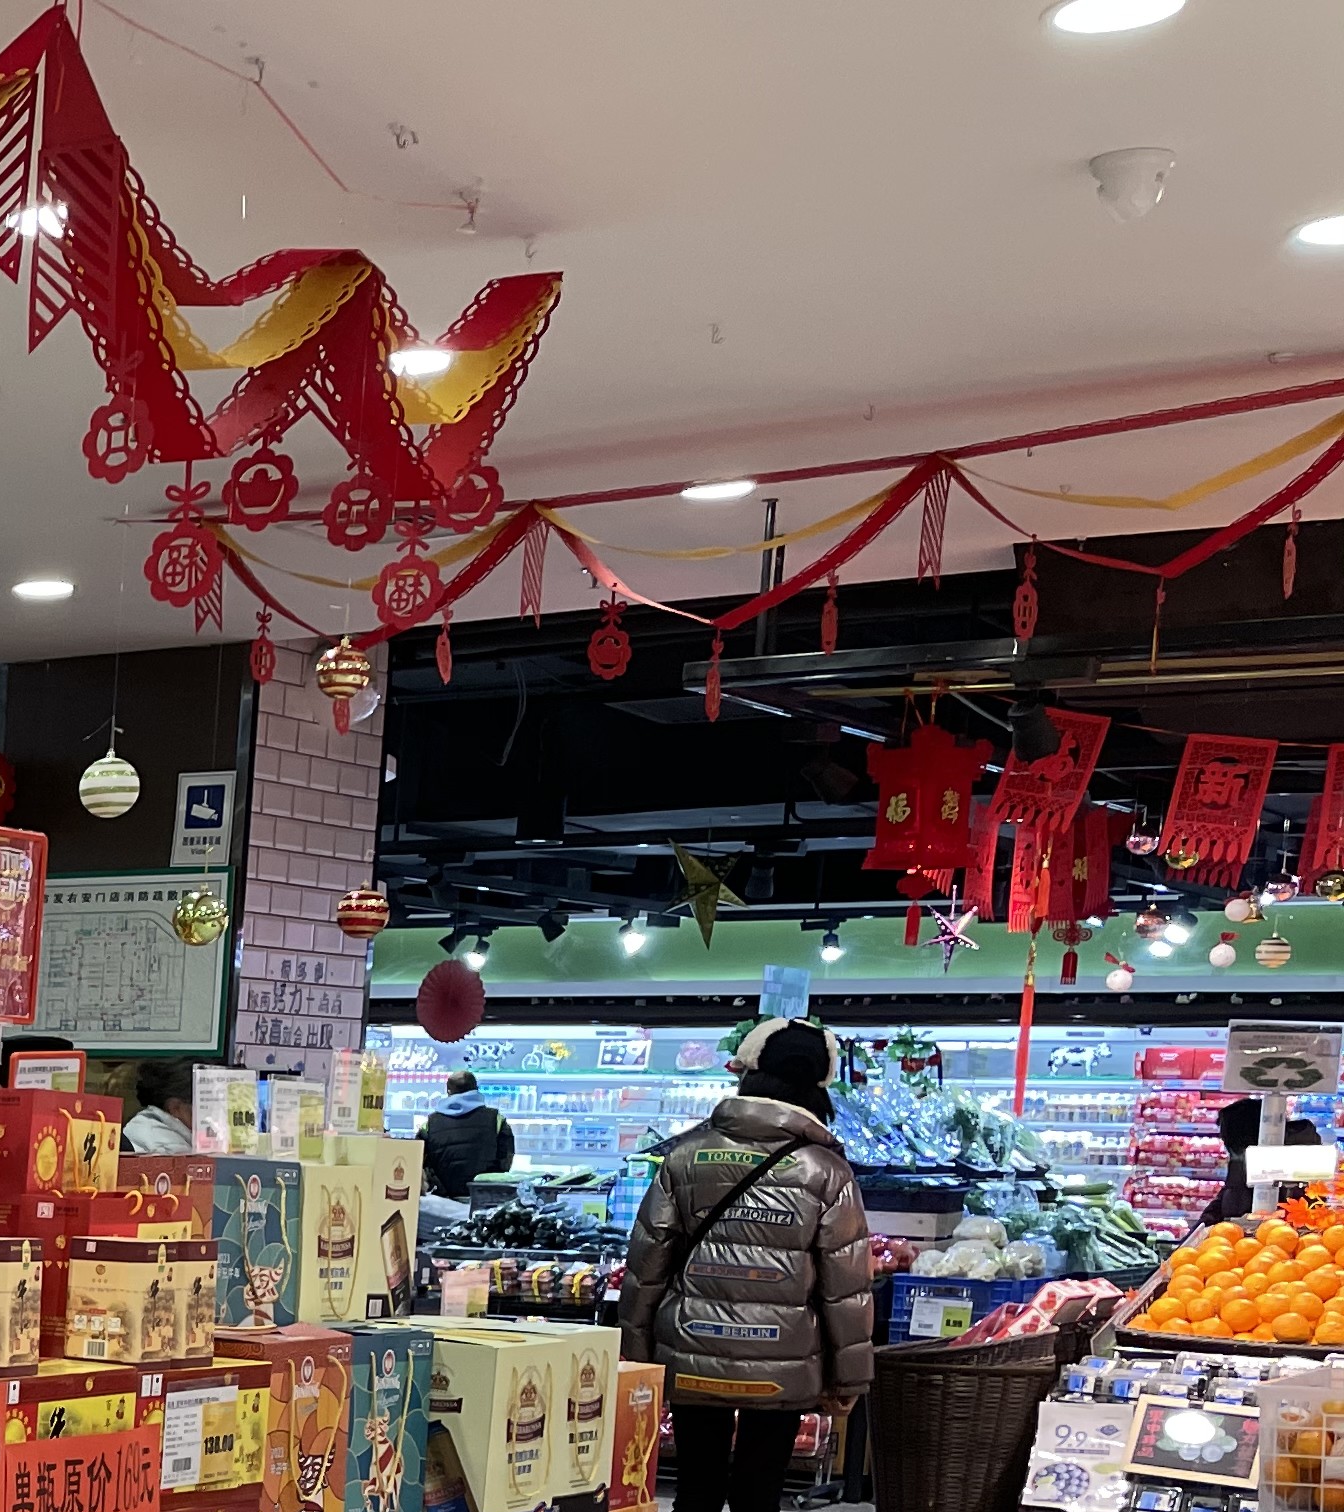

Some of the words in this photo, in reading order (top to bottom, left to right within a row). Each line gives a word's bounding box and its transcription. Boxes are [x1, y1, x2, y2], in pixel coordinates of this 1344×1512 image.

[254, 1014, 334, 1049] 惊喜就会出现
[705, 1151, 754, 1164] TOKYO
[721, 1327, 771, 1338] BERLIN
